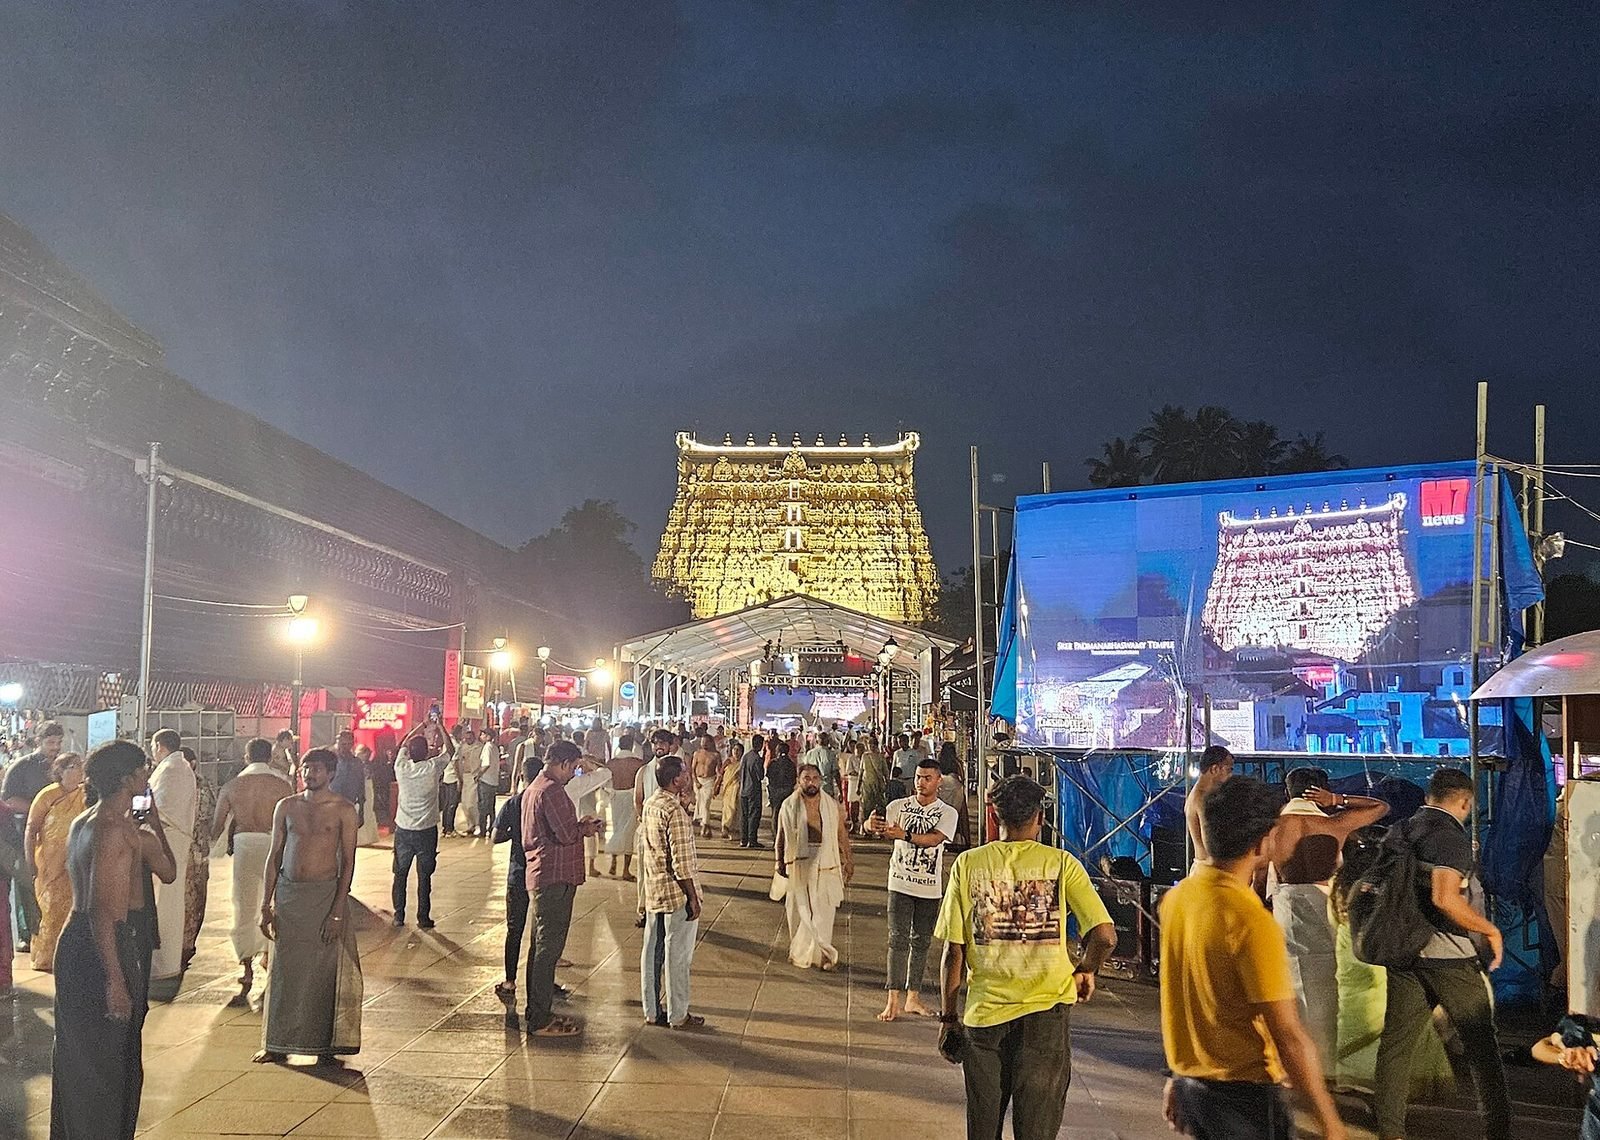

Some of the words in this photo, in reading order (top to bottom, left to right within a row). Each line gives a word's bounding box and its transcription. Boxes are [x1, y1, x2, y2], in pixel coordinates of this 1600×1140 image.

[1421, 479, 1470, 516] M7
[1422, 515, 1466, 526] news
[1147, 640, 1175, 650] TEMPLE
[900, 801, 925, 817] South
[905, 874, 936, 886] Angeles
